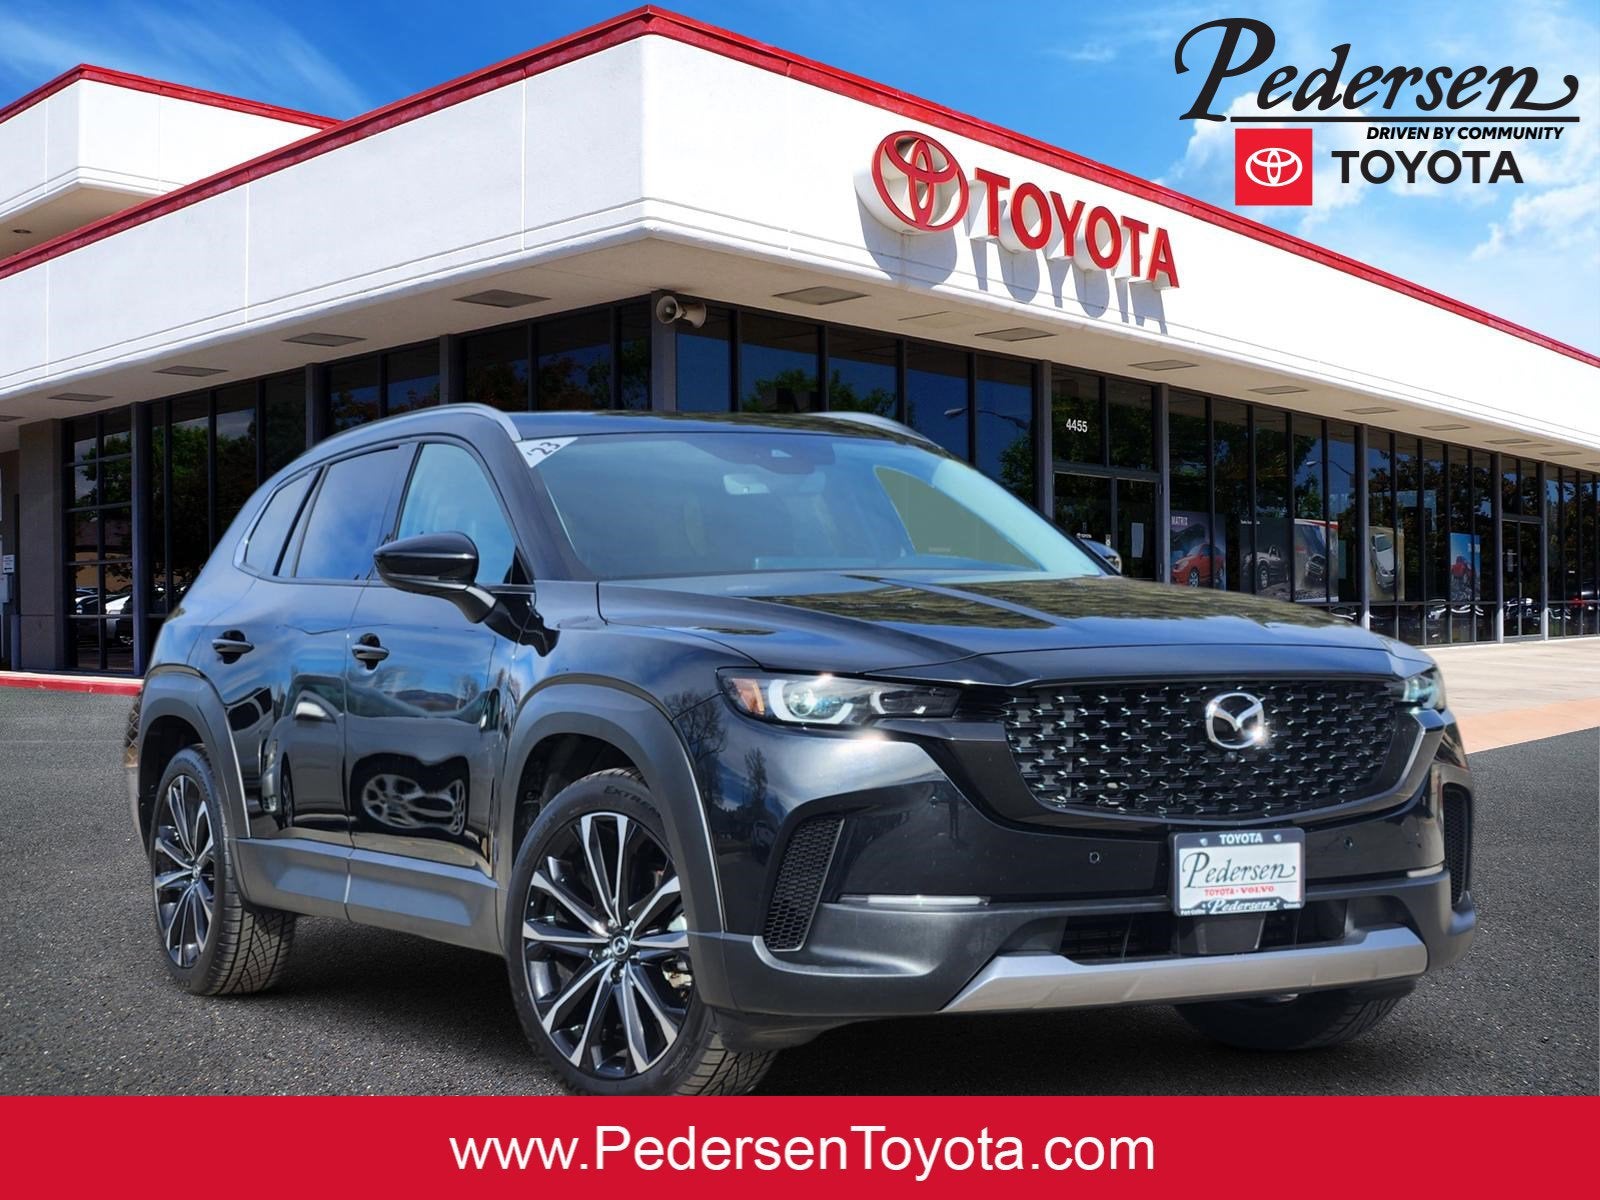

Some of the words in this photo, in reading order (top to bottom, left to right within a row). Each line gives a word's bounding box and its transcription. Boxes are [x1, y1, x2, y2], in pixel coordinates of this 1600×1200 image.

[975, 167, 1180, 289] TOYOTA
[1065, 418, 1088, 433] 4455
[1219, 832, 1264, 845] TOYOTA
[1181, 851, 1297, 889] Pedersen
[1204, 888, 1235, 897] TOYOTA
[1240, 885, 1275, 894] VOLVO
[1207, 899, 1278, 915] Pedersen
